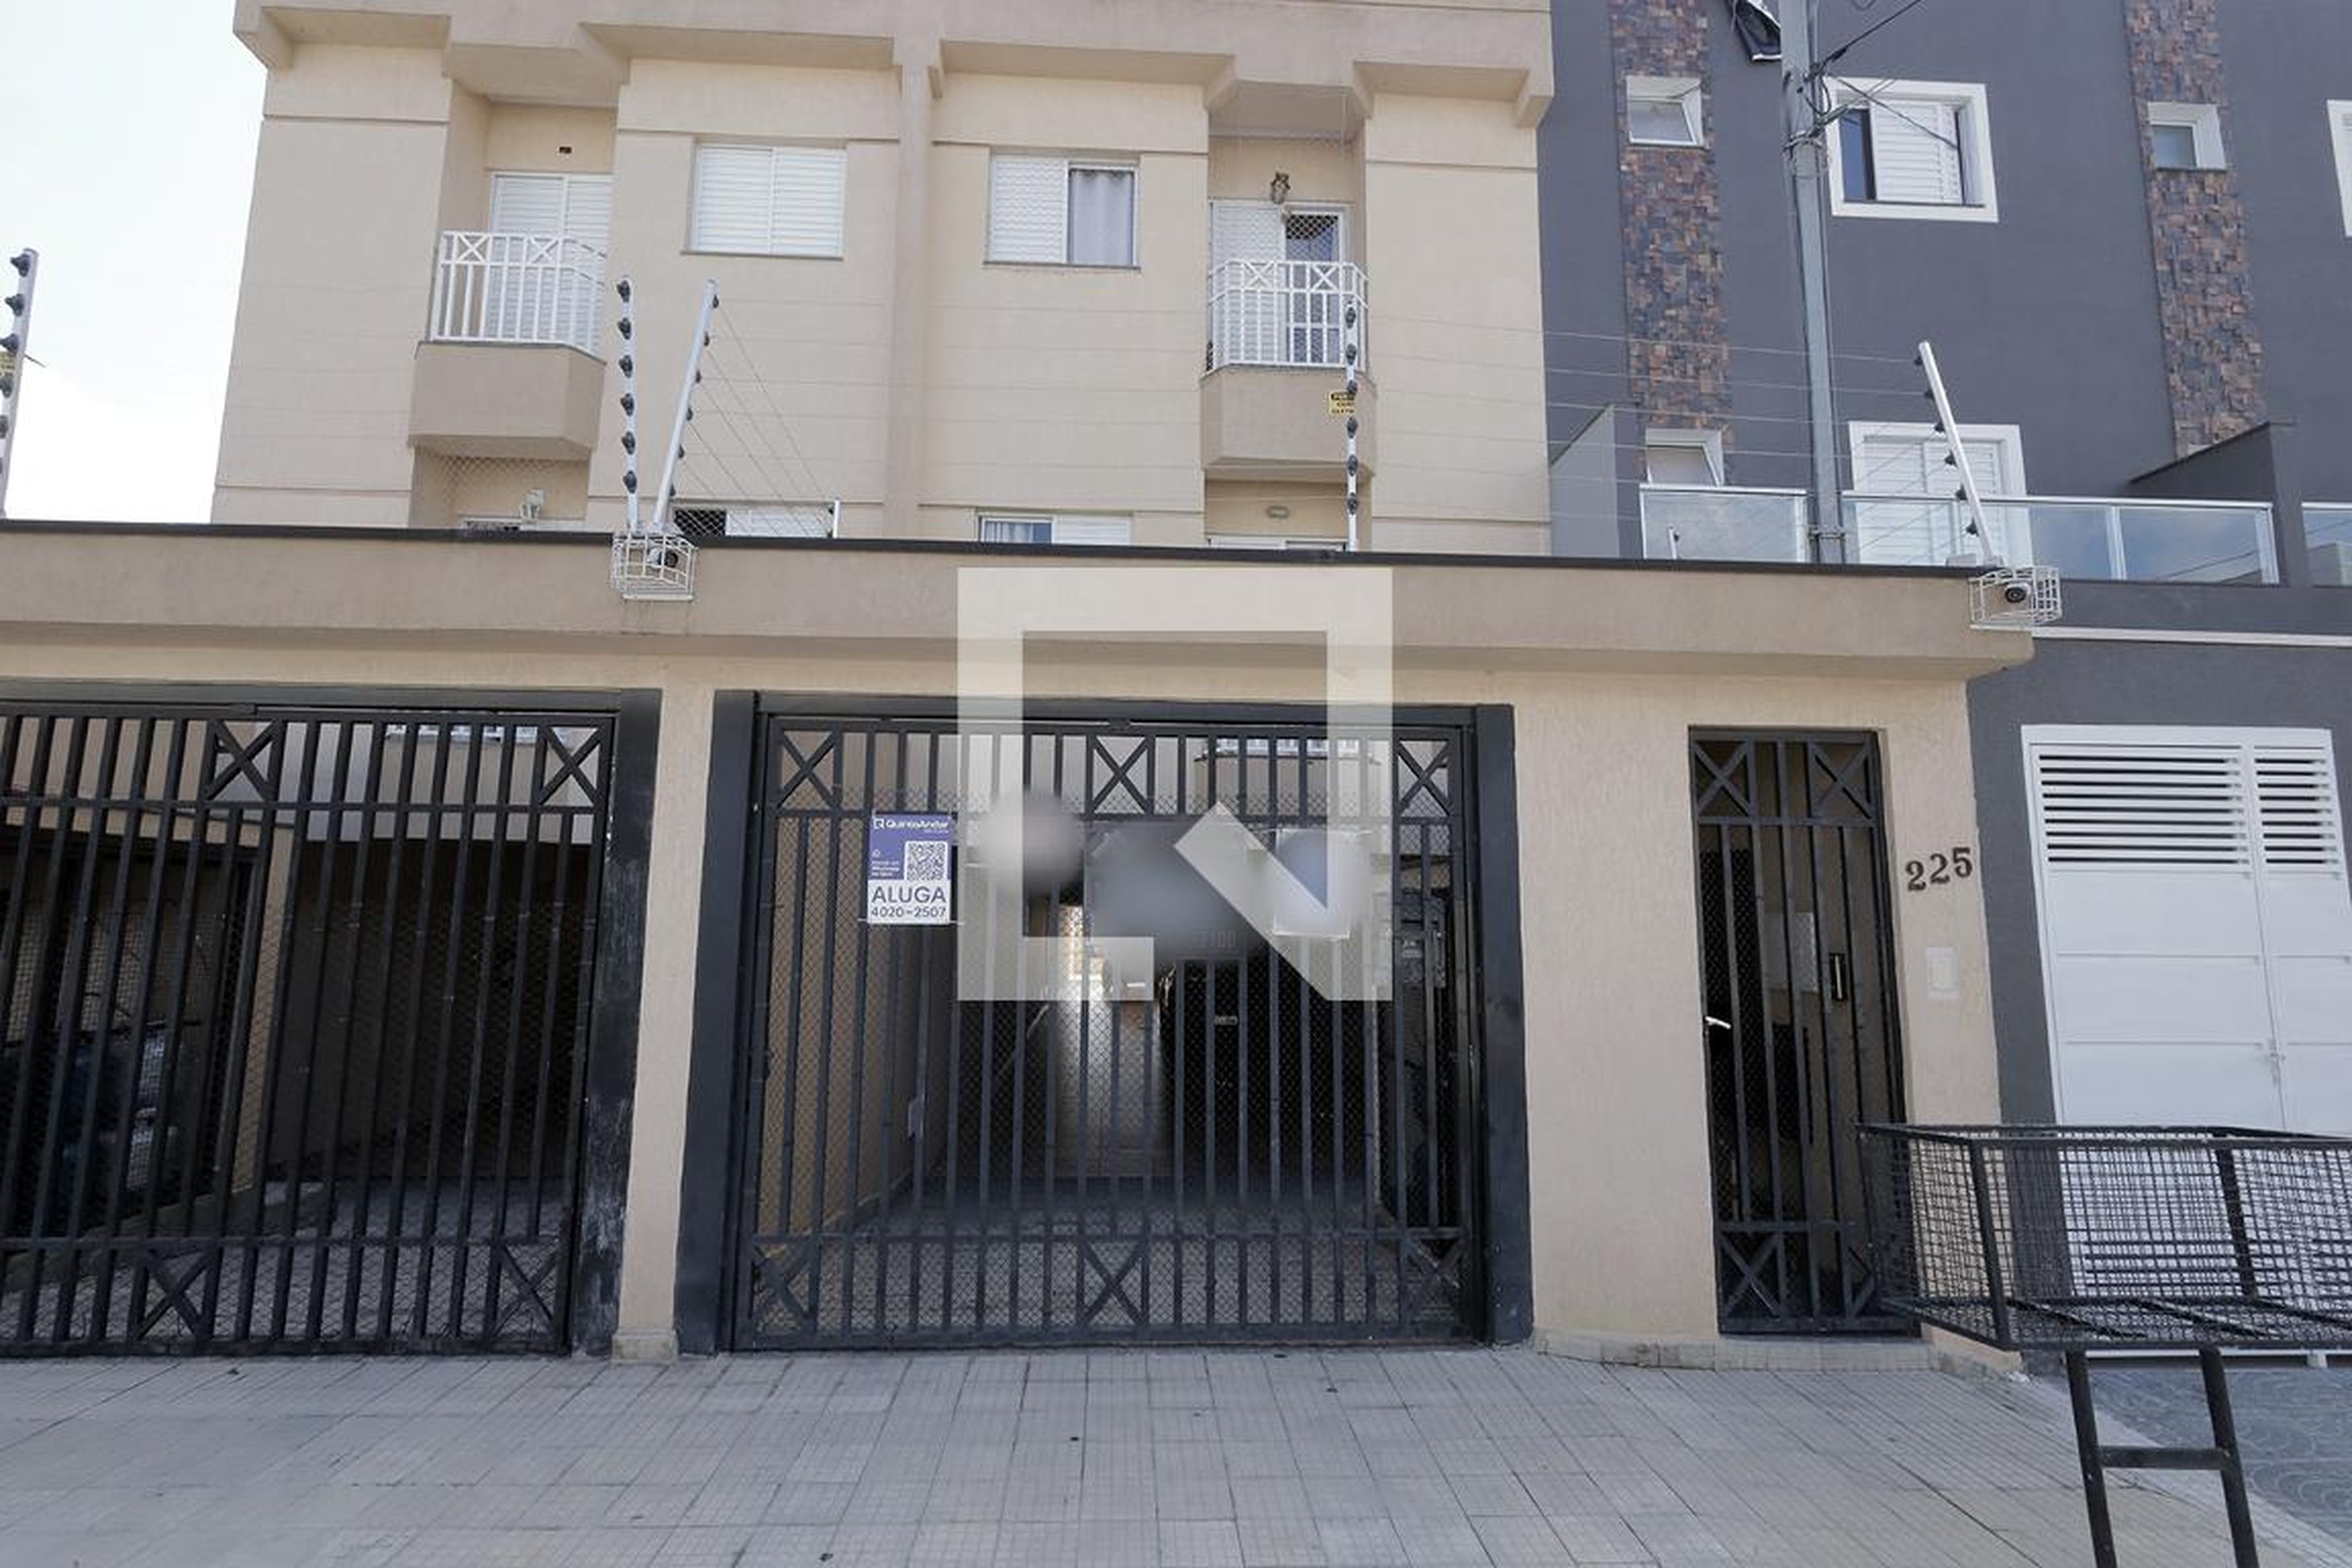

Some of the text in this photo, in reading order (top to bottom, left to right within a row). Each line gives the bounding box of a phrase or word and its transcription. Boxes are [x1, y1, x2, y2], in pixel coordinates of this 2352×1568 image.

[1905, 846, 1972, 891] 225
[872, 886, 946, 903] ALUGA
[871, 907, 946, 918] 4020-2507
